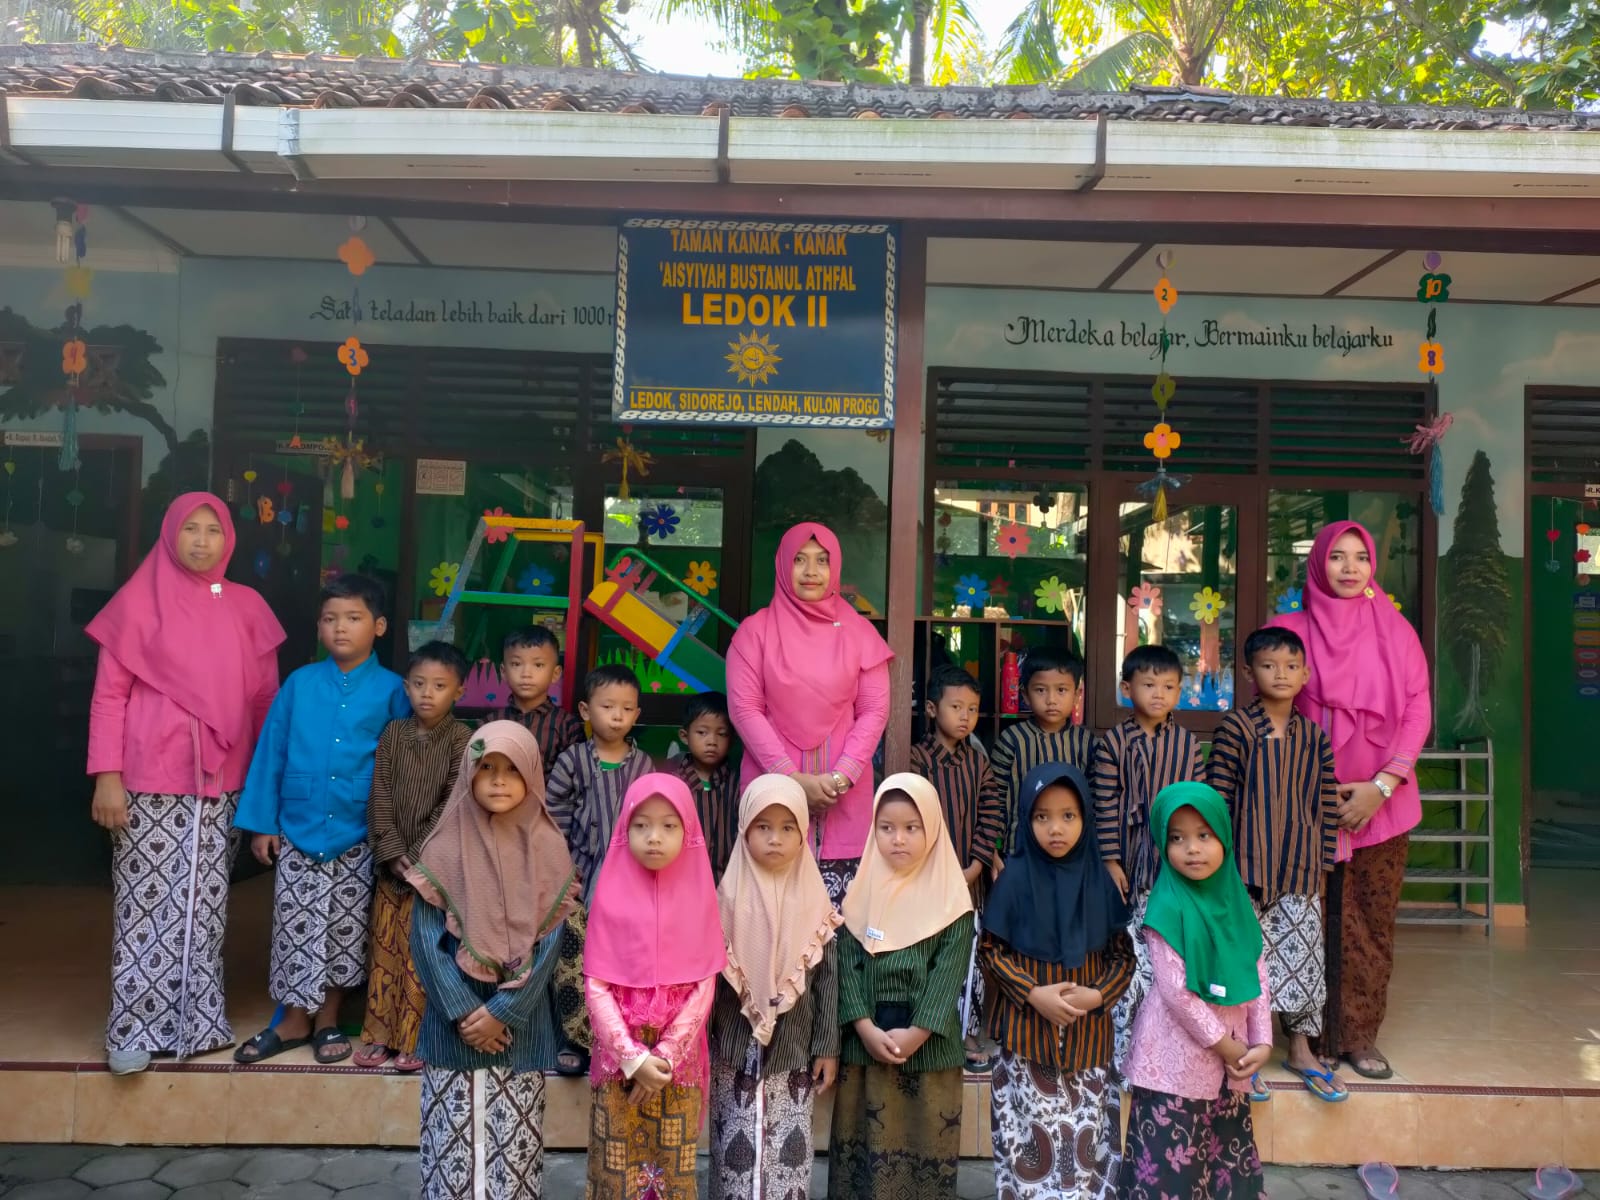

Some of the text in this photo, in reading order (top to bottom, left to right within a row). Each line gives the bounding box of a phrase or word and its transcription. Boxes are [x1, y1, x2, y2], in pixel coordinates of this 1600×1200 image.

[670, 230, 724, 253] TAMAN
[727, 231, 781, 255] KANAK
[793, 232, 848, 256] KANAK
[659, 261, 857, 291] 'AISYIYAH BUSTANUL ATHFAL
[1424, 277, 1442, 299] 10
[1161, 287, 1168, 302] 2
[368, 299, 437, 323] teladan
[440, 299, 484, 324] lebih
[487, 301, 524, 325] baik
[528, 303, 567, 326] dari
[573, 306, 606, 326] 1000
[682, 292, 828, 328] LEDOK II
[1004, 314, 1114, 347] Merdeka
[1194, 319, 1308, 349] Bermainku
[1312, 323, 1394, 358] belajarku
[348, 348, 358, 367] 3
[1427, 349, 1437, 367] 8
[629, 390, 881, 415] LEDOK, SIDOREJO, LENDAH, KULON PROGO
